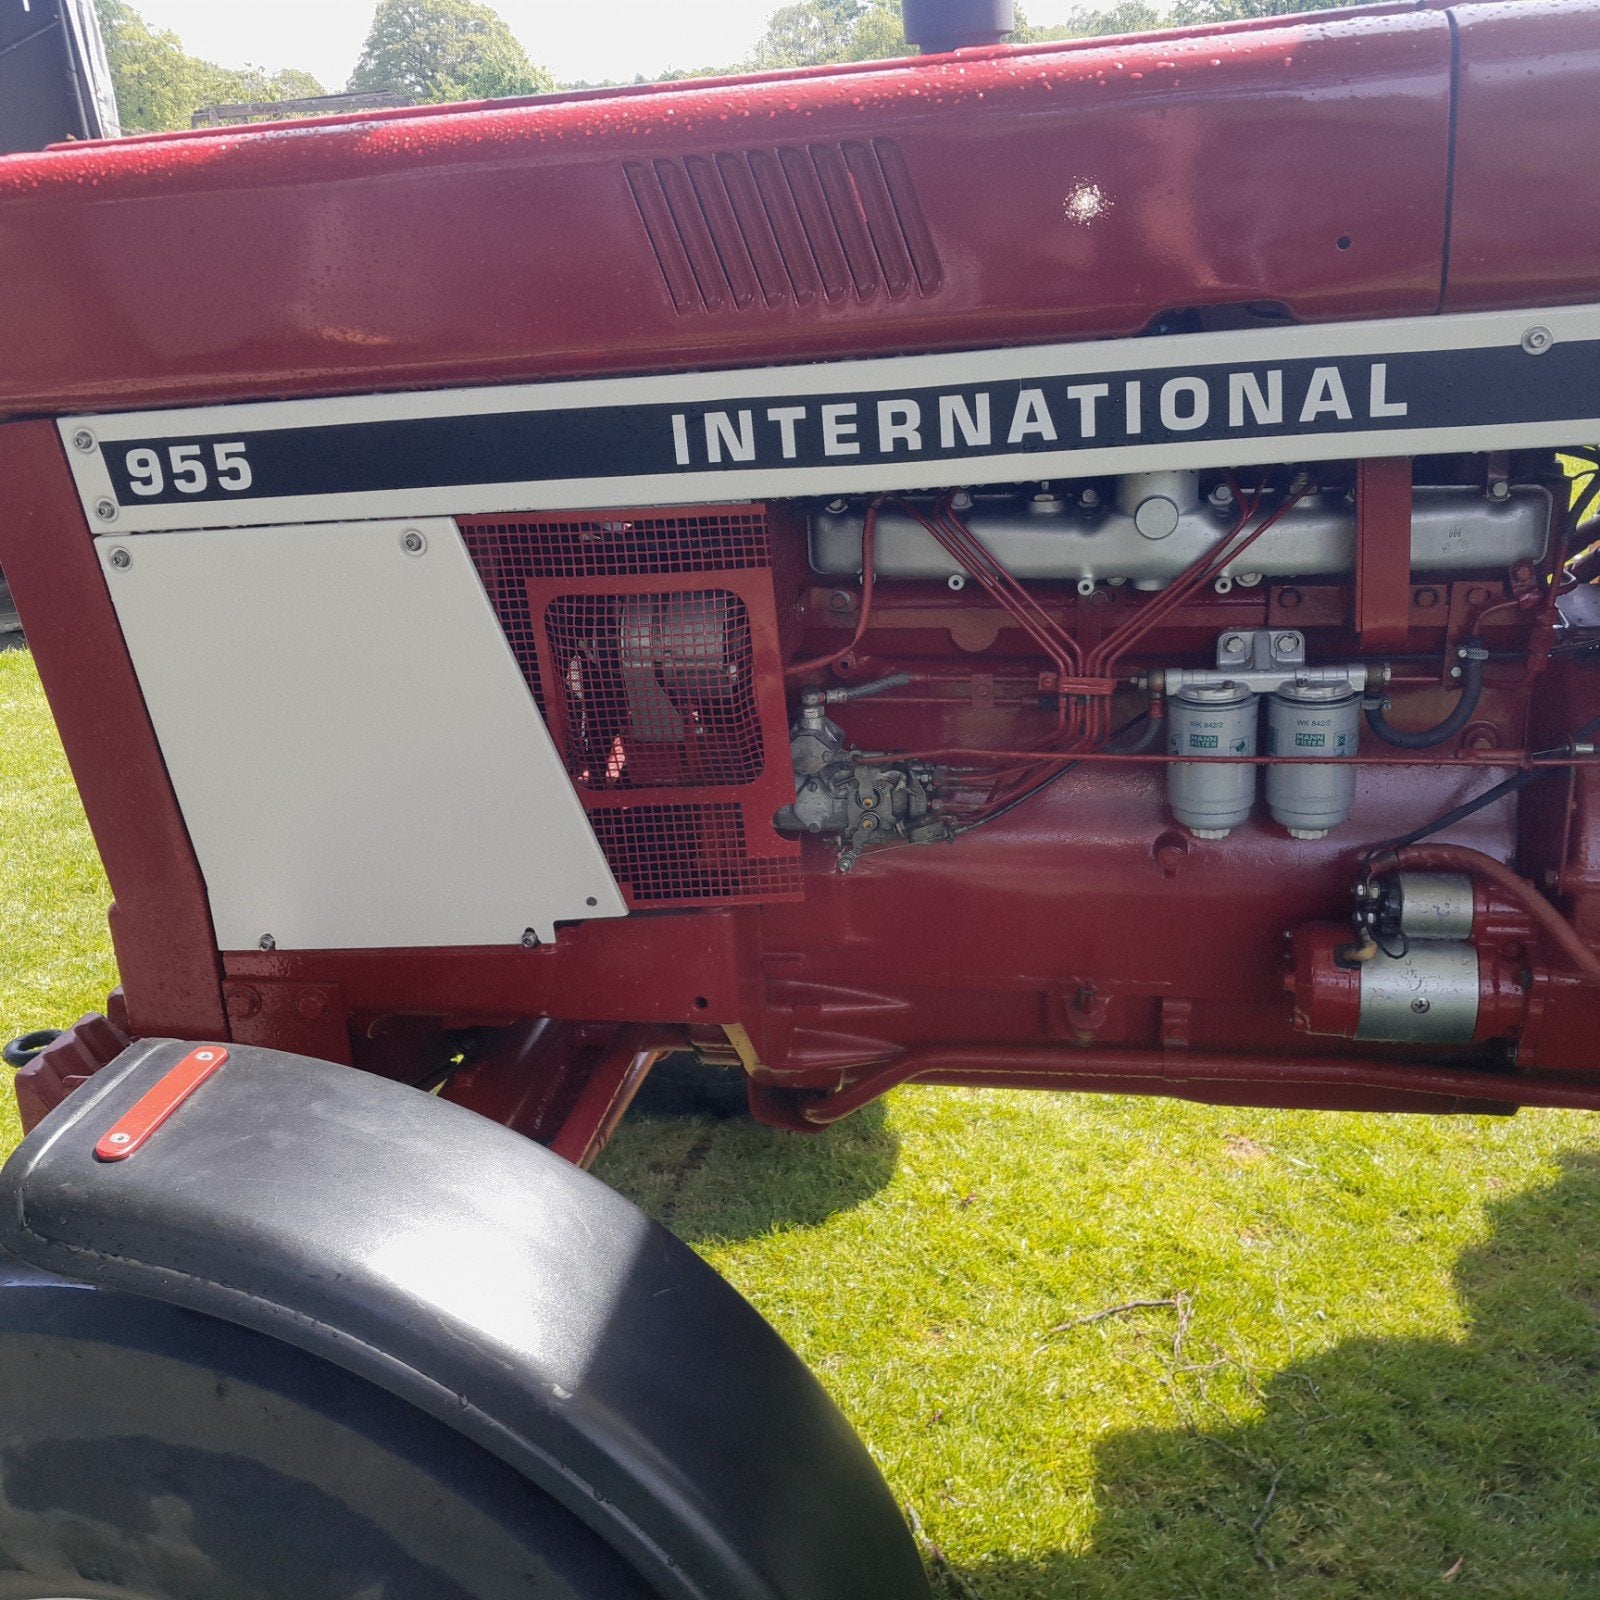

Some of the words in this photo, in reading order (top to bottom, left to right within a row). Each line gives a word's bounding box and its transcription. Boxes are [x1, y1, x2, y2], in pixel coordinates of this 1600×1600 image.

[671, 362, 1408, 467] INTERNATIONAL
[125, 441, 253, 496] 955
[1190, 721, 1202, 729] WK
[1203, 721, 1224, 729] 842/2
[1296, 719, 1309, 727] WK
[1191, 734, 1217, 742] MANN
